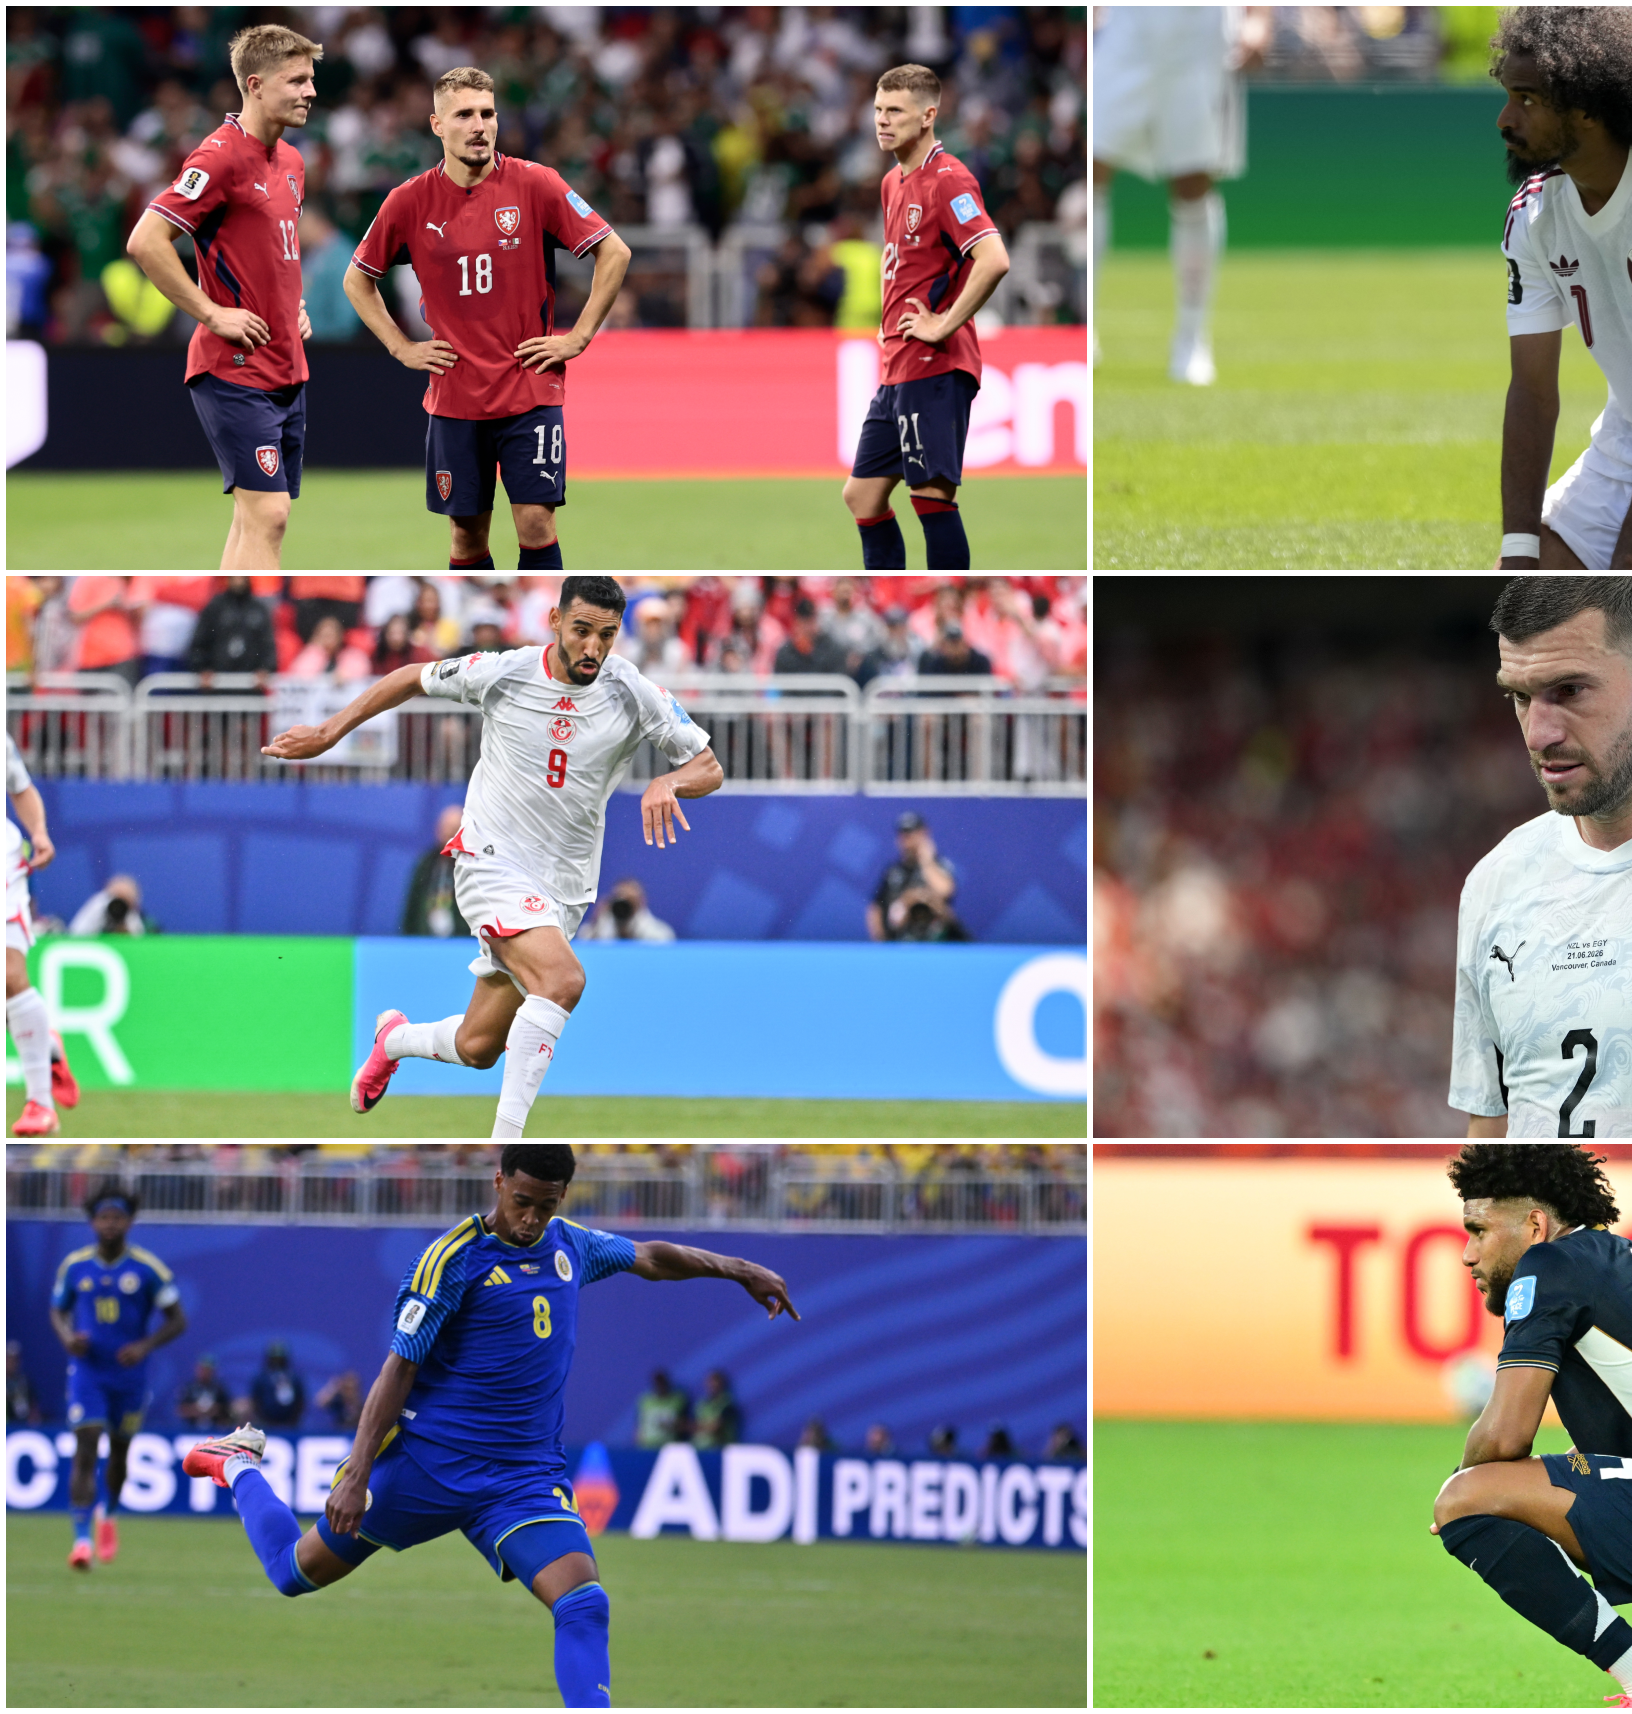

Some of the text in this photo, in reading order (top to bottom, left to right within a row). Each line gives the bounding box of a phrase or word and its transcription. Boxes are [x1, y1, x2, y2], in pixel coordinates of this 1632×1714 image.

[279, 220, 299, 260] 12
[457, 253, 493, 296] 18
[532, 424, 563, 464] 18
[898, 413, 923, 452] 21
[546, 748, 568, 789] 9
[1567, 949, 1604, 960] 21.06.2026
[1592, 939, 1608, 948] EGY
[1551, 958, 1617, 972] Vancouver, Canada
[1558, 1028, 1598, 1138] 2
[533, 1295, 552, 1339] 8
[630, 1442, 820, 1544] ADI
